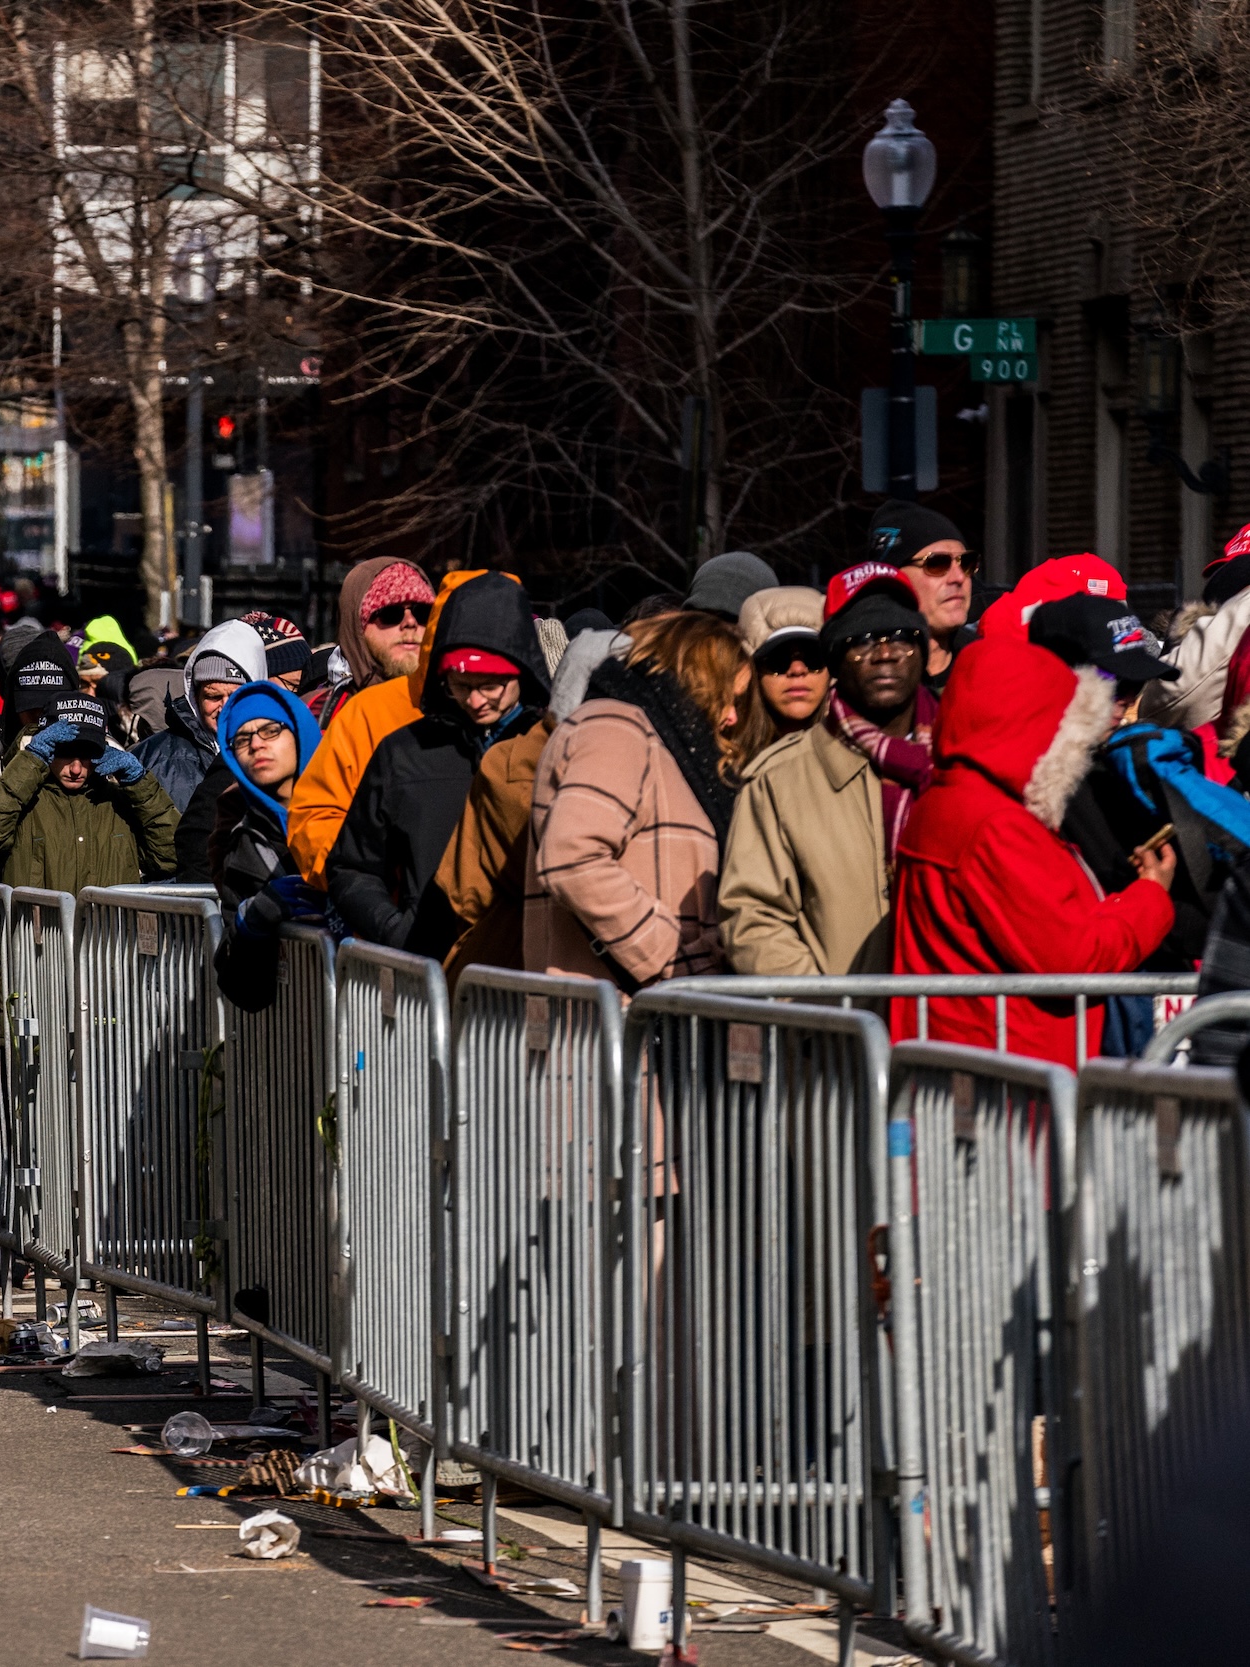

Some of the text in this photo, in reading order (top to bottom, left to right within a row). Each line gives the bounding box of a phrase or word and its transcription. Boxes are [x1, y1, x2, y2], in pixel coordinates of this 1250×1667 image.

[954, 321, 1023, 352] G PL
[996, 337, 1024, 352] NW
[981, 359, 1029, 379] 900
[18, 675, 64, 686] GREAT AGAIN
[56, 699, 105, 715] MAKE AMERICA
[58, 712, 104, 728] GREAT AGAIN
